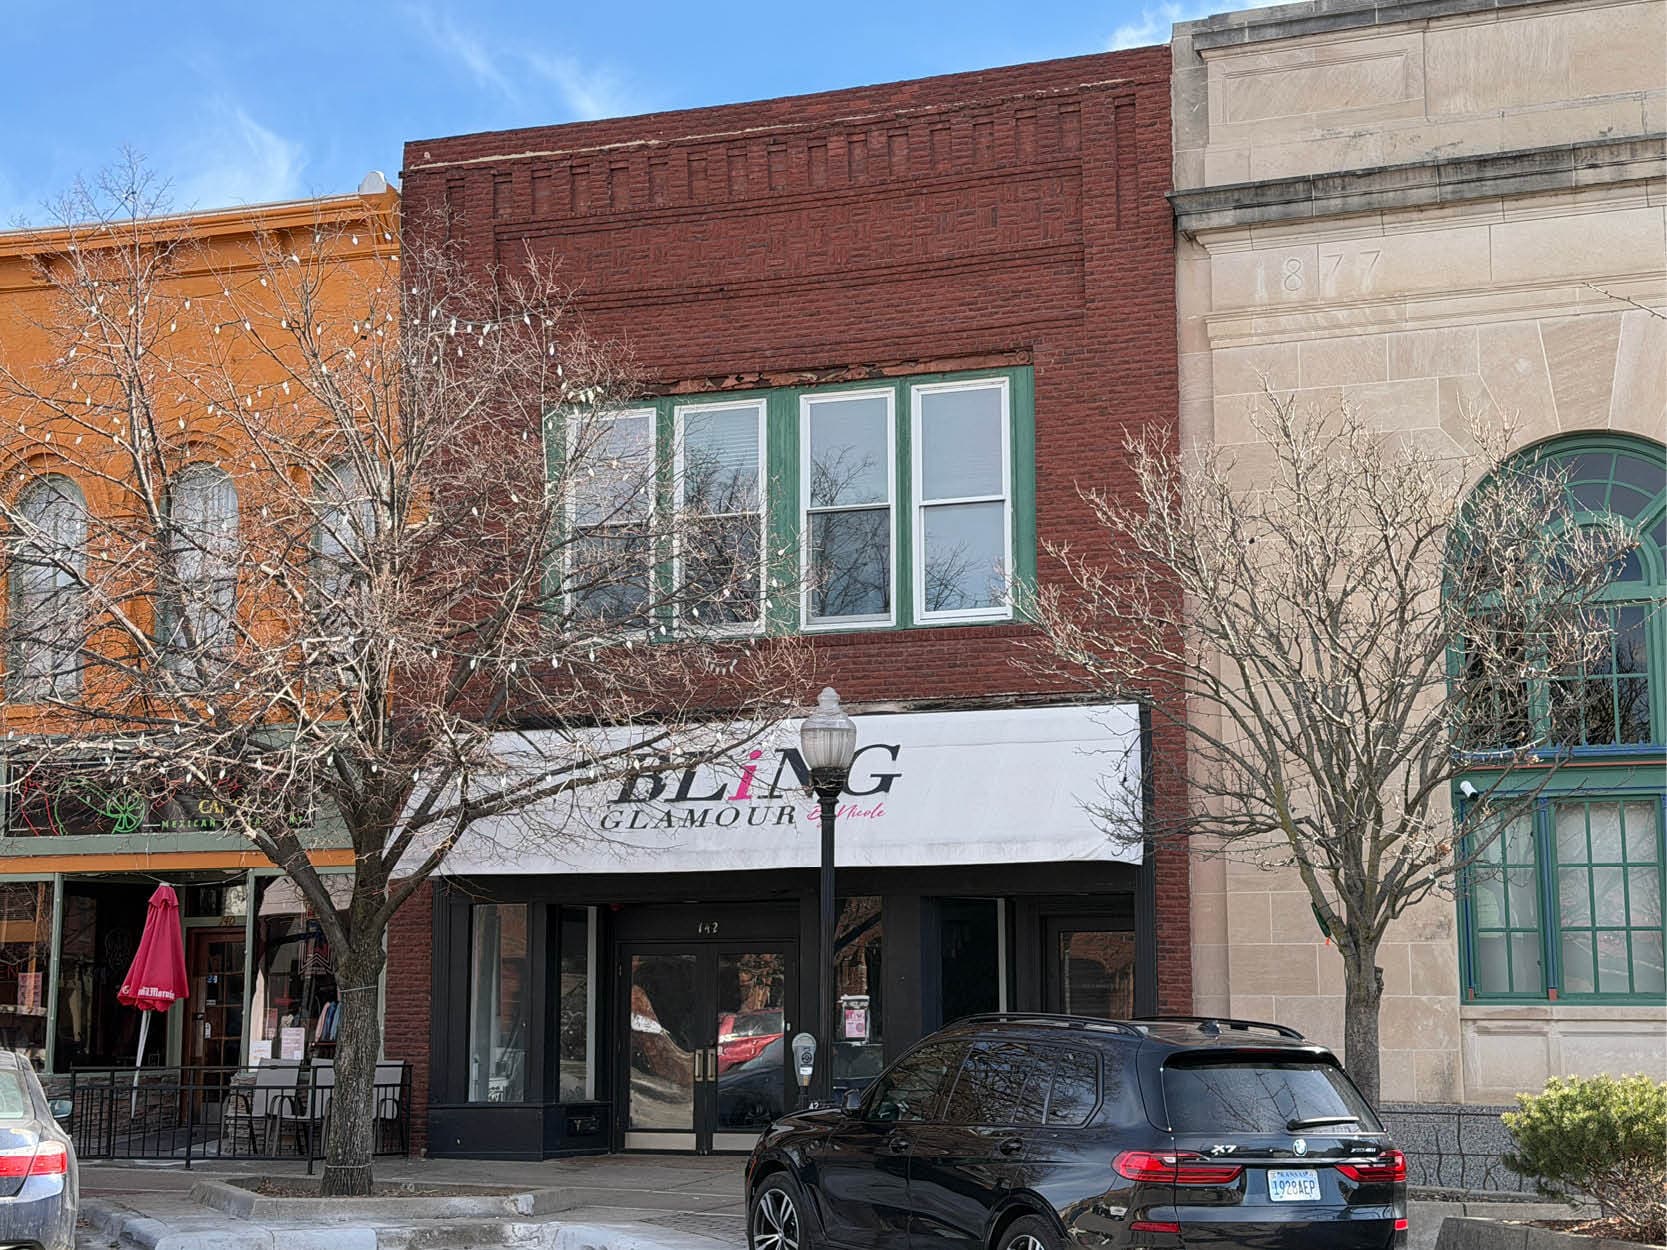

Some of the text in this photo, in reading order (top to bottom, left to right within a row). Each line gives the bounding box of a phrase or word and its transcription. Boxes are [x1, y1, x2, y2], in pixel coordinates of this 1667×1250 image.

[1255, 250, 1380, 303] 1877
[600, 804, 796, 830] GLAMOUR
[837, 802, 886, 820] Nicole
[161, 819, 216, 829] MEXICAN
[1211, 1144, 1237, 1155] X7
